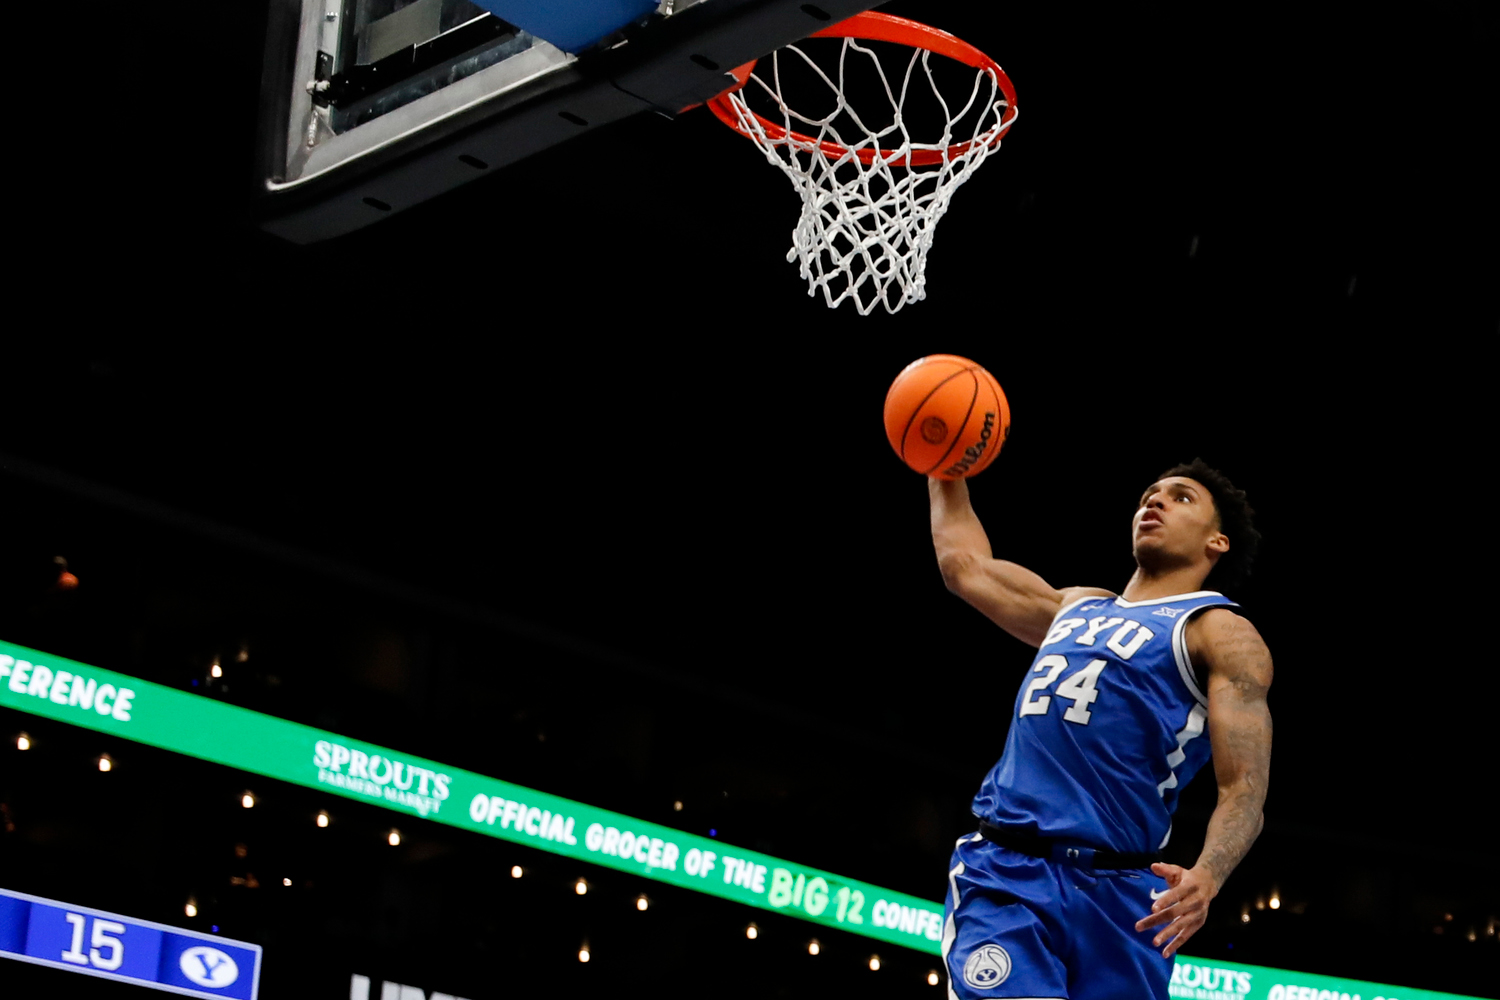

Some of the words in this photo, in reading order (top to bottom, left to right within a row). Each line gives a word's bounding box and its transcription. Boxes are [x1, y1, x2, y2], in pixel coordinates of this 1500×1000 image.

[1049, 616, 1155, 660] BYU
[1019, 654, 1108, 725] 24
[313, 740, 453, 801] SPROUTS
[469, 793, 577, 846] OFFICIAL
[585, 822, 680, 871] GROCER
[684, 847, 717, 878] OF
[721, 855, 768, 894] THE
[768, 867, 829, 916] BIG
[836, 886, 866, 925] 12
[872, 899, 943, 942] CONFE
[61, 912, 126, 971] 15
